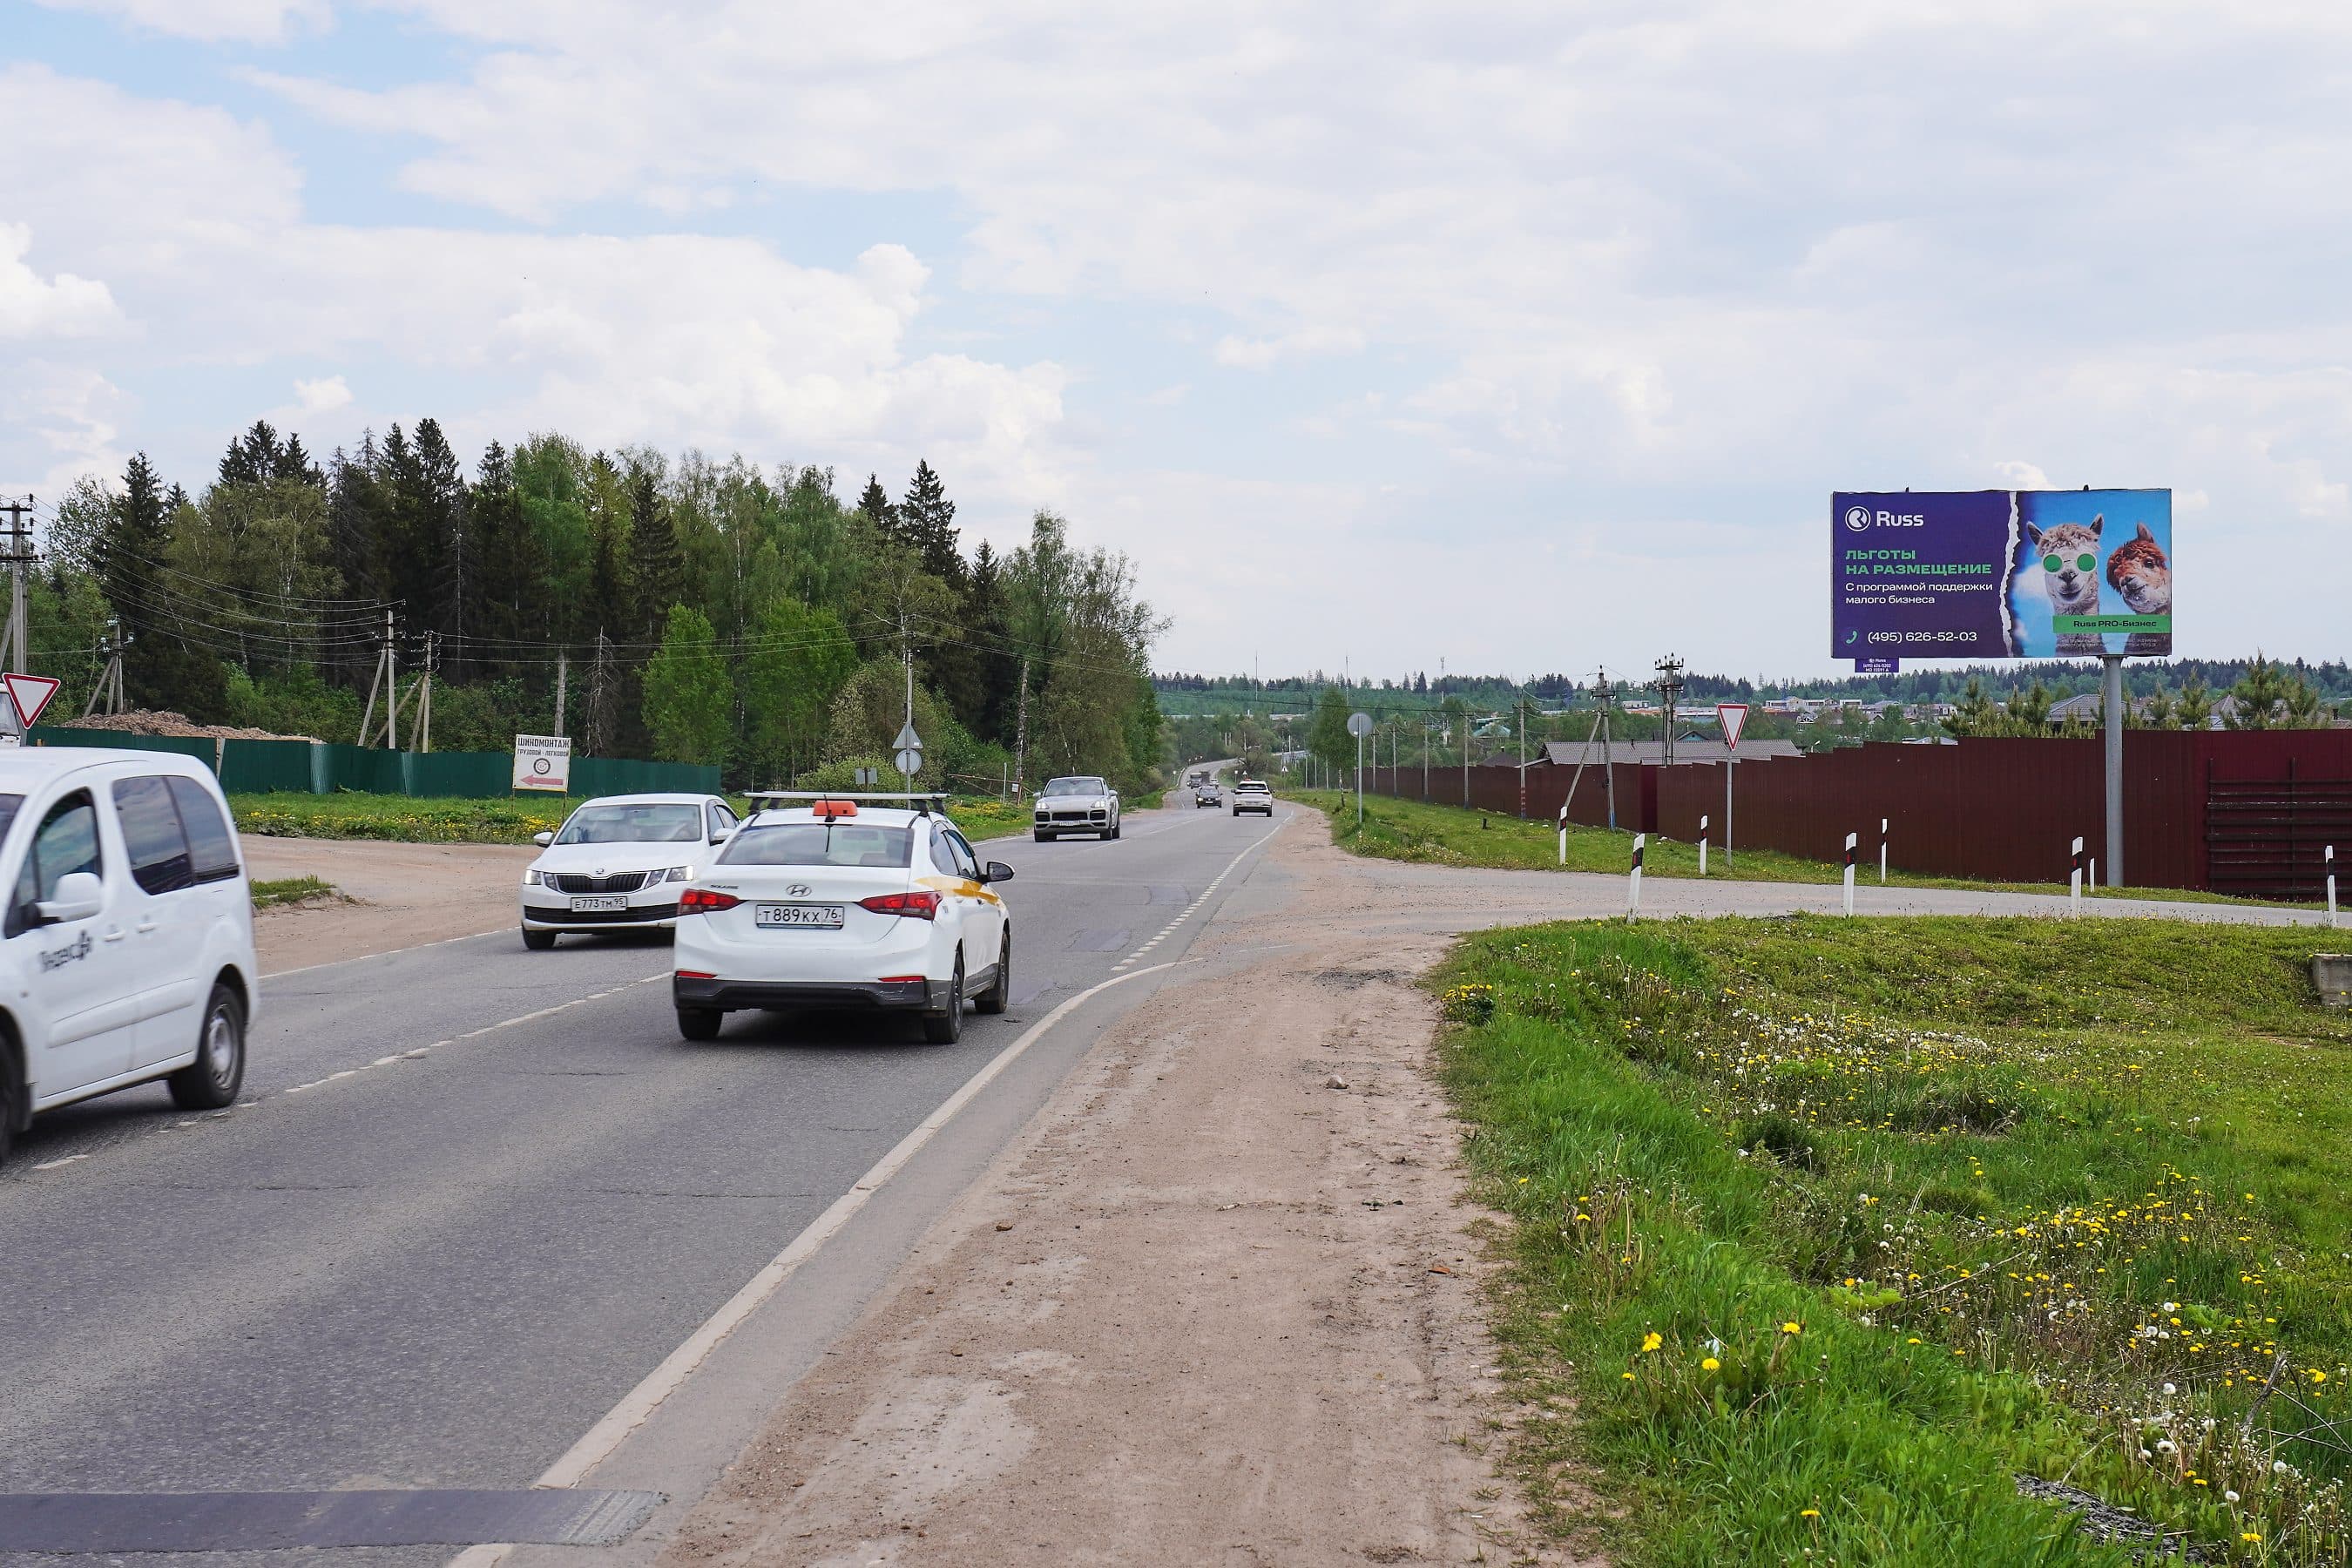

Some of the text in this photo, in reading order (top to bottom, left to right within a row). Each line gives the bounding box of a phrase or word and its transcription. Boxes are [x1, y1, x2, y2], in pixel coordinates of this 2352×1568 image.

[1876, 510, 1924, 527] Russ
[1845, 550, 1916, 560] ЛЬГОТЫ
[1846, 564, 1992, 576] НА РАЗМЕЩЕНИЕ
[1845, 582, 1993, 592] С программой поддержки
[1889, 595, 1936, 604] бизнеса
[1868, 632, 1977, 644] (495) 626-52-03
[517, 738, 570, 748] ШИНОМОНТАЖ
